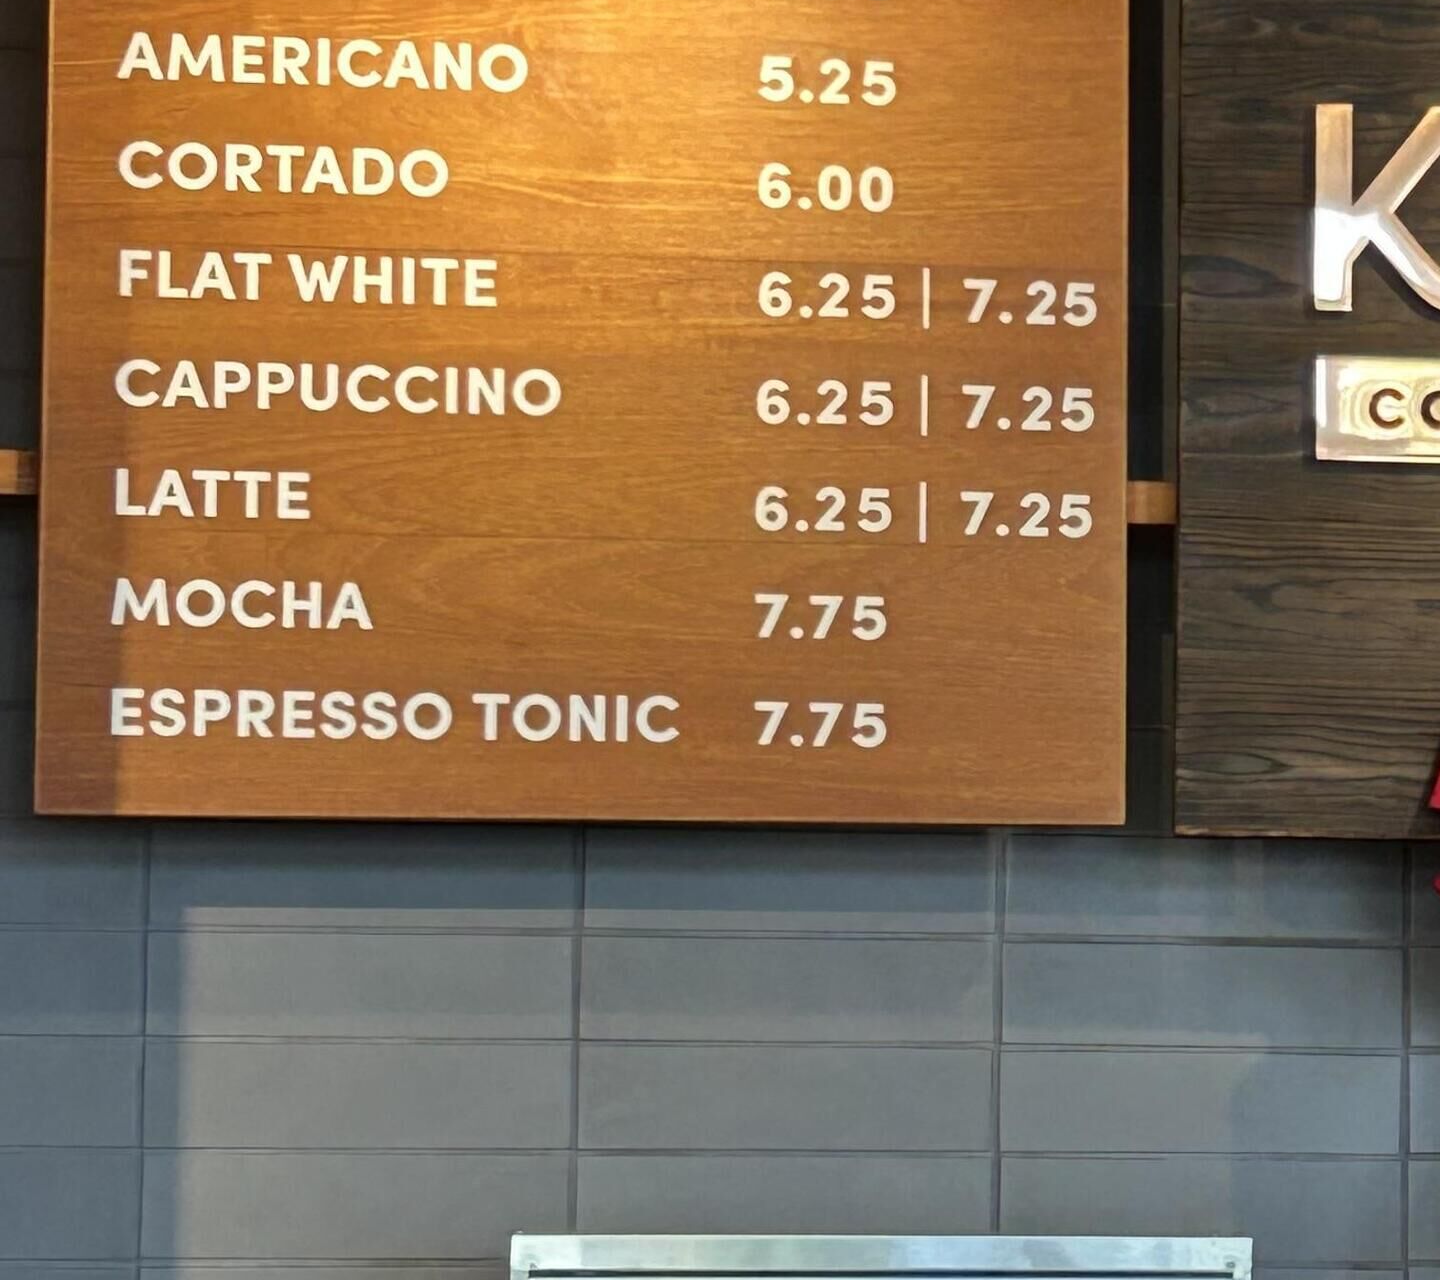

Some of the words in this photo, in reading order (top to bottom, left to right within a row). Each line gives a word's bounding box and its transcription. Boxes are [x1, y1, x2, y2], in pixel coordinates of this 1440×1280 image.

[117, 31, 529, 93] AMERICANO
[757, 54, 896, 106] 5.25
[118, 140, 449, 198] CORTADO
[757, 162, 894, 213] 6.00
[119, 249, 273, 301] FLAT
[287, 253, 497, 307] WHITE
[758, 271, 896, 319] 6.25
[963, 278, 1098, 327] 7.25
[114, 358, 562, 417] CAPPUCCINO
[756, 379, 894, 426] 6.25
[961, 384, 1095, 432] 7.25
[115, 467, 311, 520] LATTE
[754, 485, 892, 533] 6.25
[960, 490, 1093, 539] 7.25
[110, 577, 374, 630] MOCHA
[754, 592, 887, 641] 7.75
[110, 687, 453, 741] ESPRESSO
[471, 692, 680, 743] TONIC
[754, 700, 887, 748] 7.75
